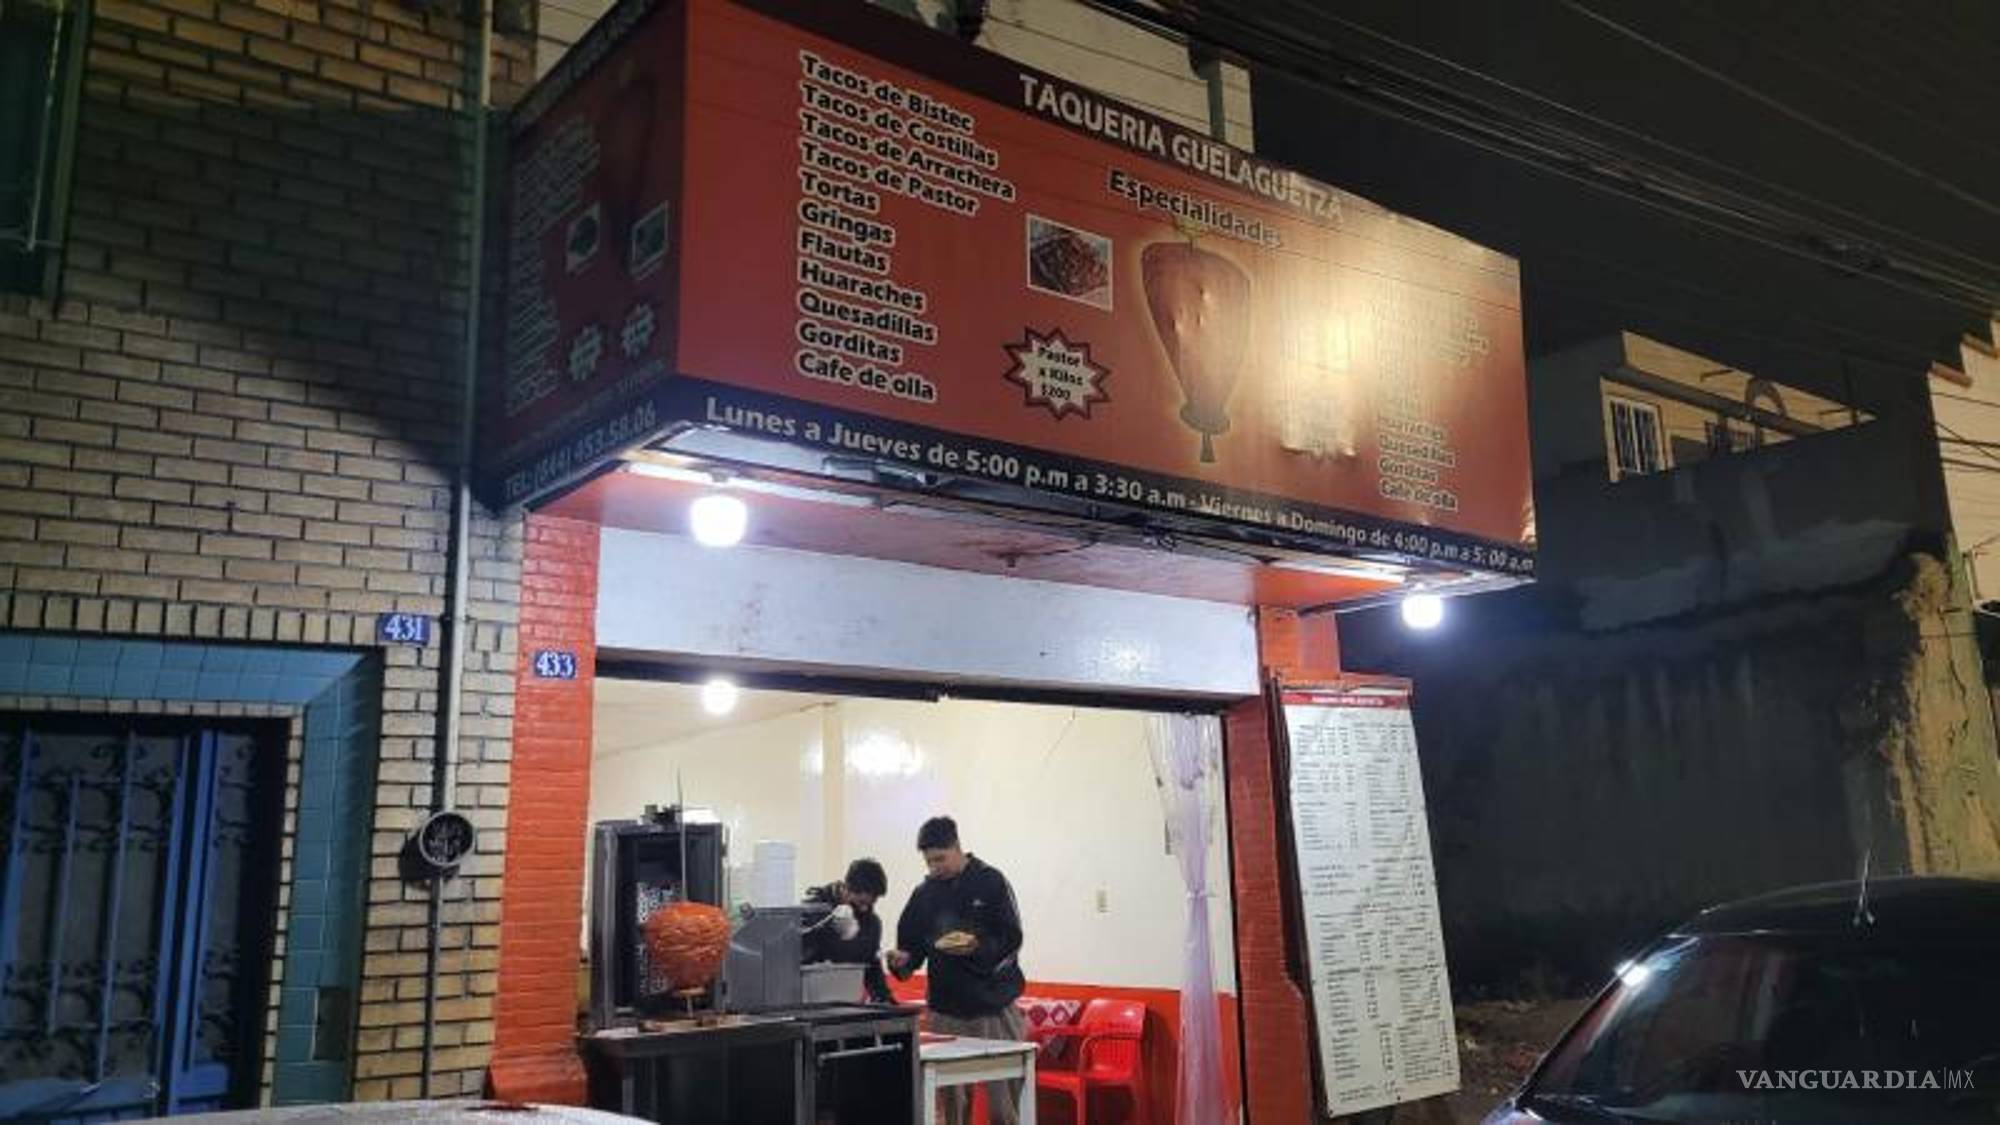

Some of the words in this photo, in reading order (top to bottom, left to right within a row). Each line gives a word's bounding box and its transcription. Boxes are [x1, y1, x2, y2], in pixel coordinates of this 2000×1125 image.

[801, 53, 868, 95] Tacos
[875, 81, 902, 106] de
[909, 94, 972, 133] Bistec
[801, 82, 868, 123] Tacos
[875, 109, 902, 135] de
[908, 121, 997, 167] Costillas
[1019, 73, 1166, 157] TAQUERIA
[1172, 133, 1344, 224] GUELAGUETZA
[801, 111, 868, 152] Tacos
[875, 138, 902, 163] de
[907, 150, 1015, 200] Arrachera
[801, 141, 868, 181] Tacos
[875, 166, 902, 191] de
[909, 176, 979, 214] Pastor
[801, 171, 879, 211] Tortas
[1108, 169, 1282, 249] Especialidades
[800, 201, 895, 246] Gringas
[800, 231, 889, 272] Flautas
[799, 261, 925, 311] Huaraches
[798, 321, 902, 363] Gorditas
[799, 292, 936, 343] Quesadillas
[798, 352, 854, 382] Cafe
[859, 365, 888, 389] de
[893, 375, 936, 401] olla
[1037, 346, 1081, 368] Pastor
[706, 396, 797, 437] Lunes
[805, 425, 822, 441] a
[828, 422, 922, 461] Jueves
[928, 440, 959, 469] de
[965, 449, 1019, 479] 5:00
[1024, 464, 1069, 489] p.m
[1074, 475, 1088, 491] a
[1095, 477, 1142, 501] 3:30
[1147, 488, 1186, 510] a.m
[1200, 494, 1273, 525] Viernes
[1277, 515, 1288, 528] a
[1290, 512, 1366, 544] Domingo
[1370, 528, 1391, 548] de
[1394, 534, 1428, 554] 4:00
[383, 614, 423, 641] 431
[536, 651, 573, 677] 433
